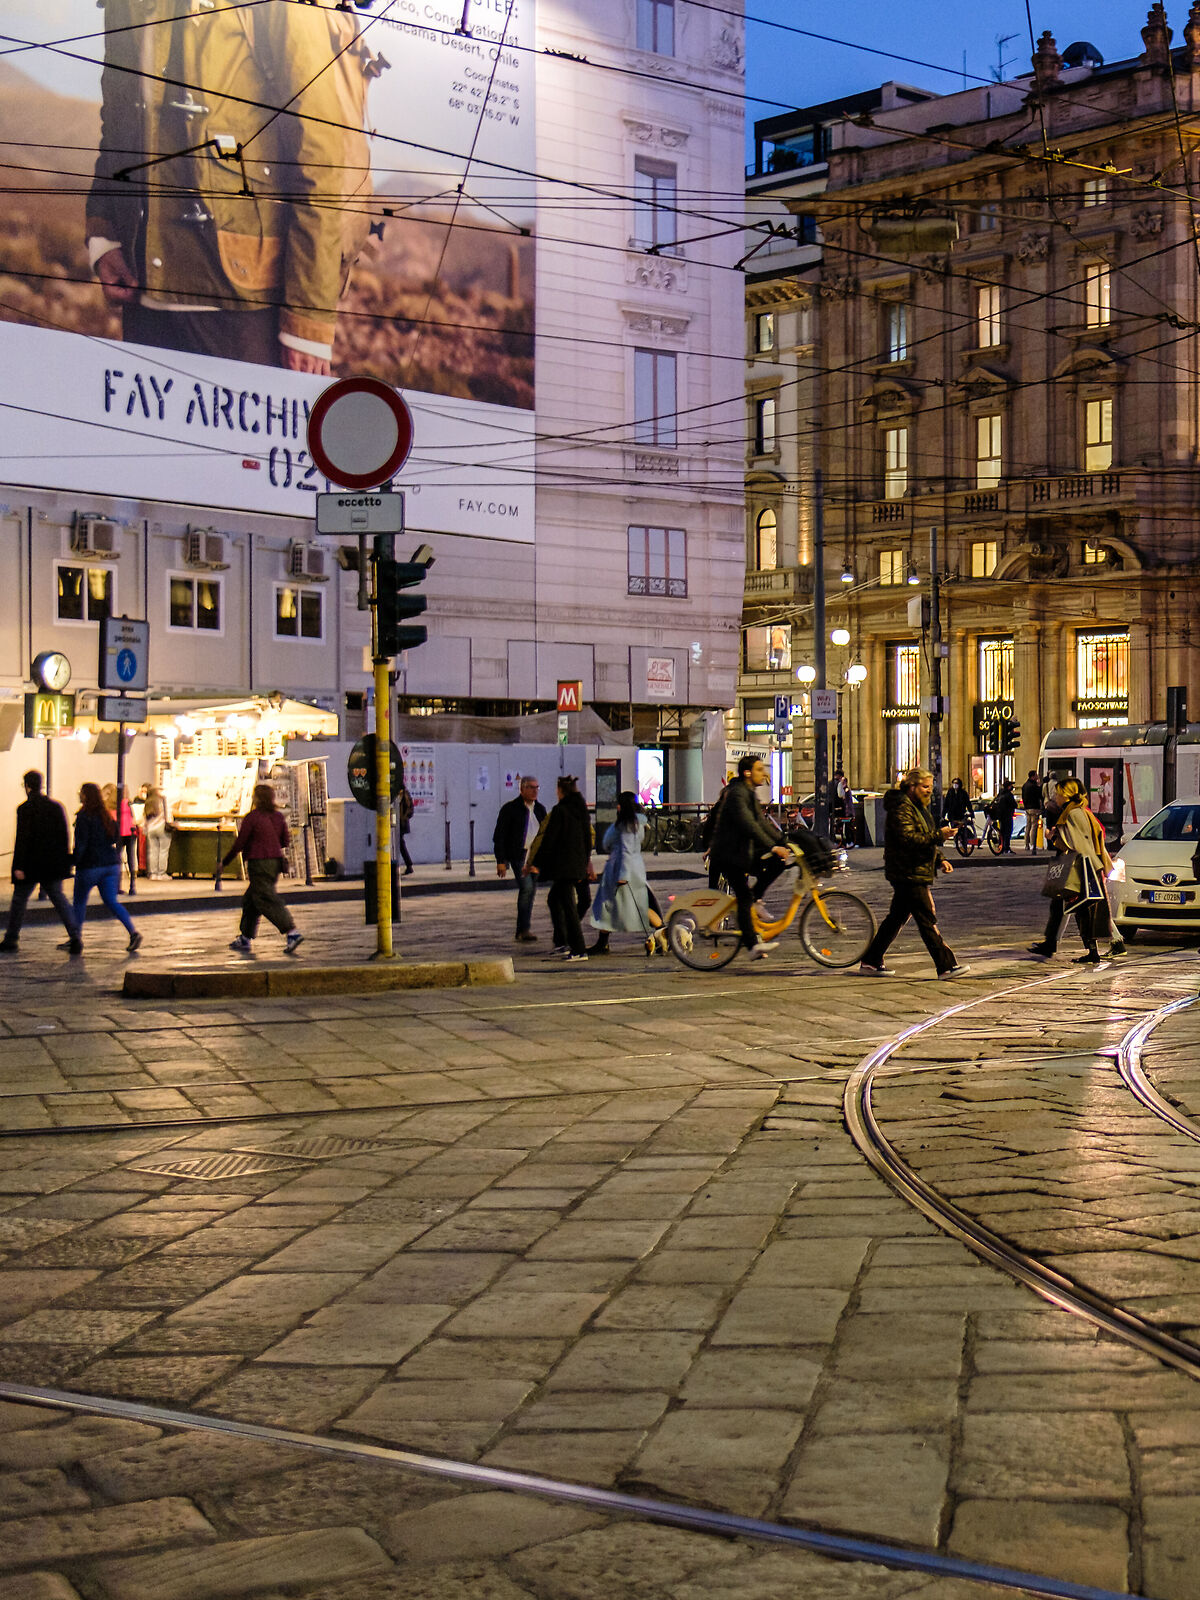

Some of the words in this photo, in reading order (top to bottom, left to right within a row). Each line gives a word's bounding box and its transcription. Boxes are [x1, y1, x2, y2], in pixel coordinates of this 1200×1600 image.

[424, 5, 519, 46] Consevationist
[381, 14, 437, 42] Atacama
[441, 34, 485, 60] Desert,
[489, 47, 519, 68] Chile
[464, 67, 519, 92] Coordinates
[510, 114, 519, 126] W
[104, 370, 173, 420] FAY
[269, 446, 331, 492] 02
[338, 496, 382, 507] eccetto
[459, 498, 519, 517] FAY.COM
[560, 687, 577, 706] M
[777, 698, 787, 717] P
